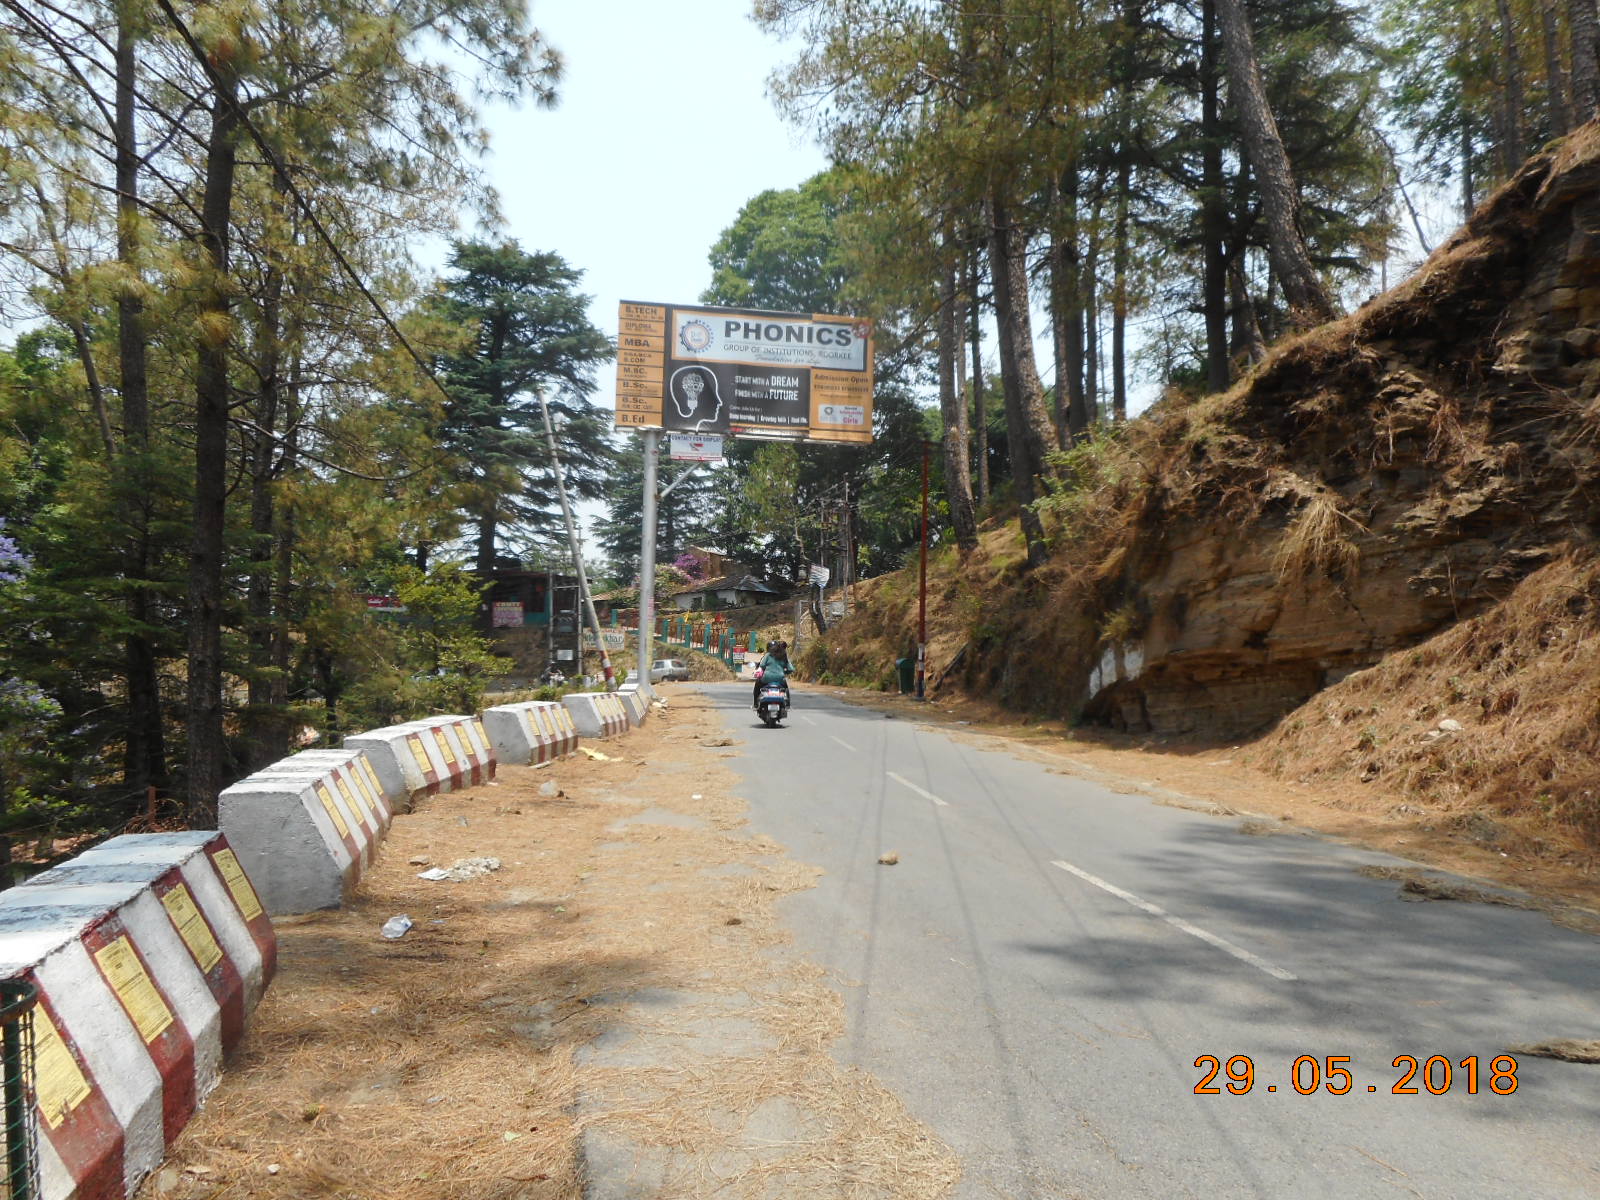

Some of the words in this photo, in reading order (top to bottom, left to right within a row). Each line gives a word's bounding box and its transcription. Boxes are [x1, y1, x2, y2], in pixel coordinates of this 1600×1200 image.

[625, 305, 657, 315] B.TECH
[724, 320, 852, 347] PHONICS
[624, 338, 650, 347] MBA
[723, 344, 749, 352] GROUP
[734, 375, 752, 384] START
[752, 377, 765, 386] WITH
[771, 375, 799, 388] DREAM
[769, 388, 799, 400] FUTURE
[622, 414, 645, 423] B.Ed
[842, 416, 859, 424] Girls
